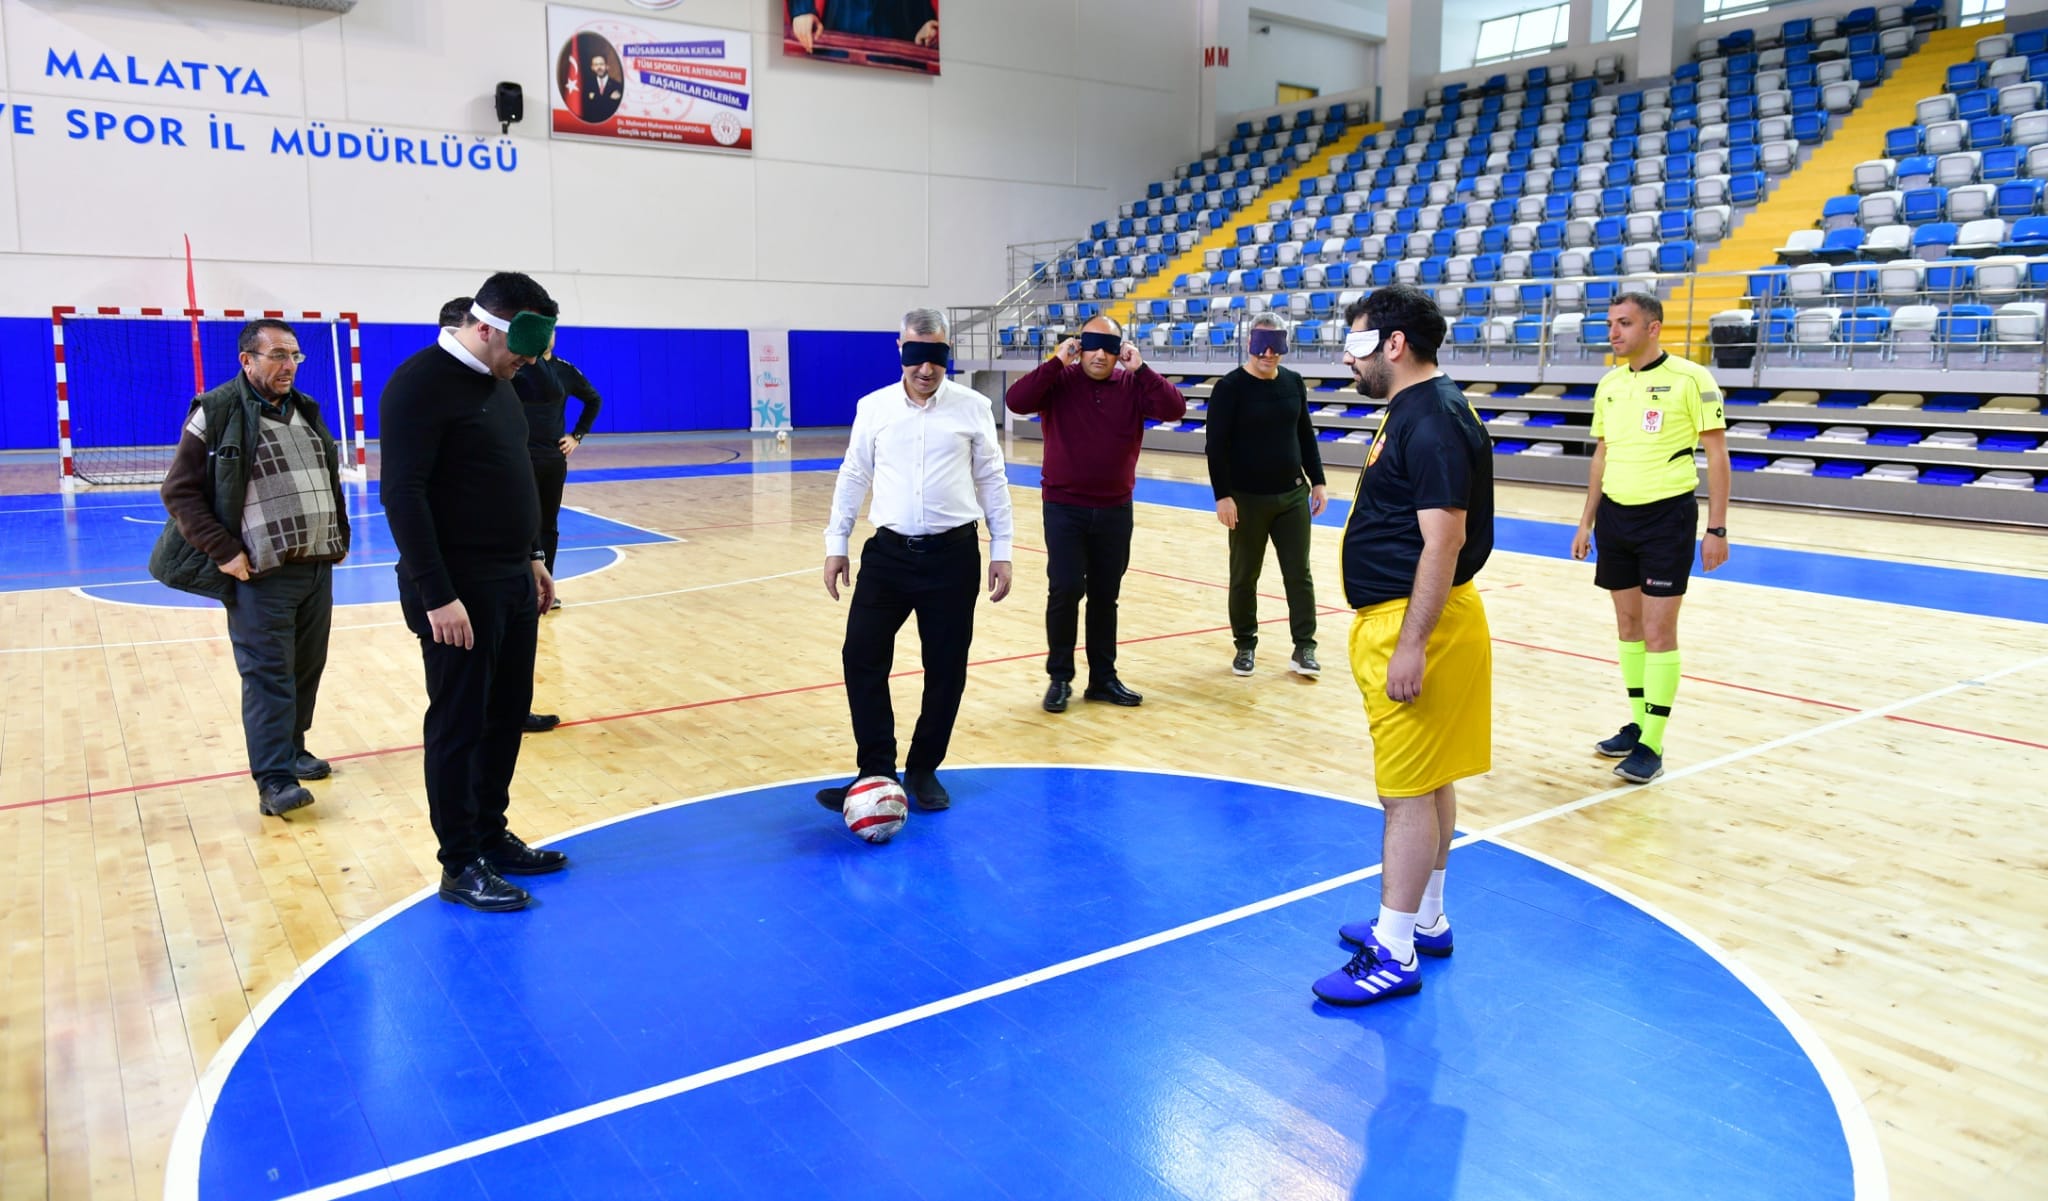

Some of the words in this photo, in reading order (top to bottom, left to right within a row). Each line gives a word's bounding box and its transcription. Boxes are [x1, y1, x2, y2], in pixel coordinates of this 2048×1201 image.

[628, 45, 690, 56] MÜSABAKALARA
[691, 46, 723, 56] KATILAN
[46, 48, 269, 97] MALATYA
[637, 59, 652, 69] TÜM
[654, 62, 681, 72] SPORCU
[682, 65, 691, 74] VE
[692, 67, 742, 81] ANTRENÖRLERE
[650, 74, 701, 96] BAŞARILAR
[702, 87, 742, 107] DİLERİM.
[66, 109, 186, 147] SPOR
[209, 113, 246, 152] İL
[271, 122, 518, 173] MÜDÜRLÜĞÜ
